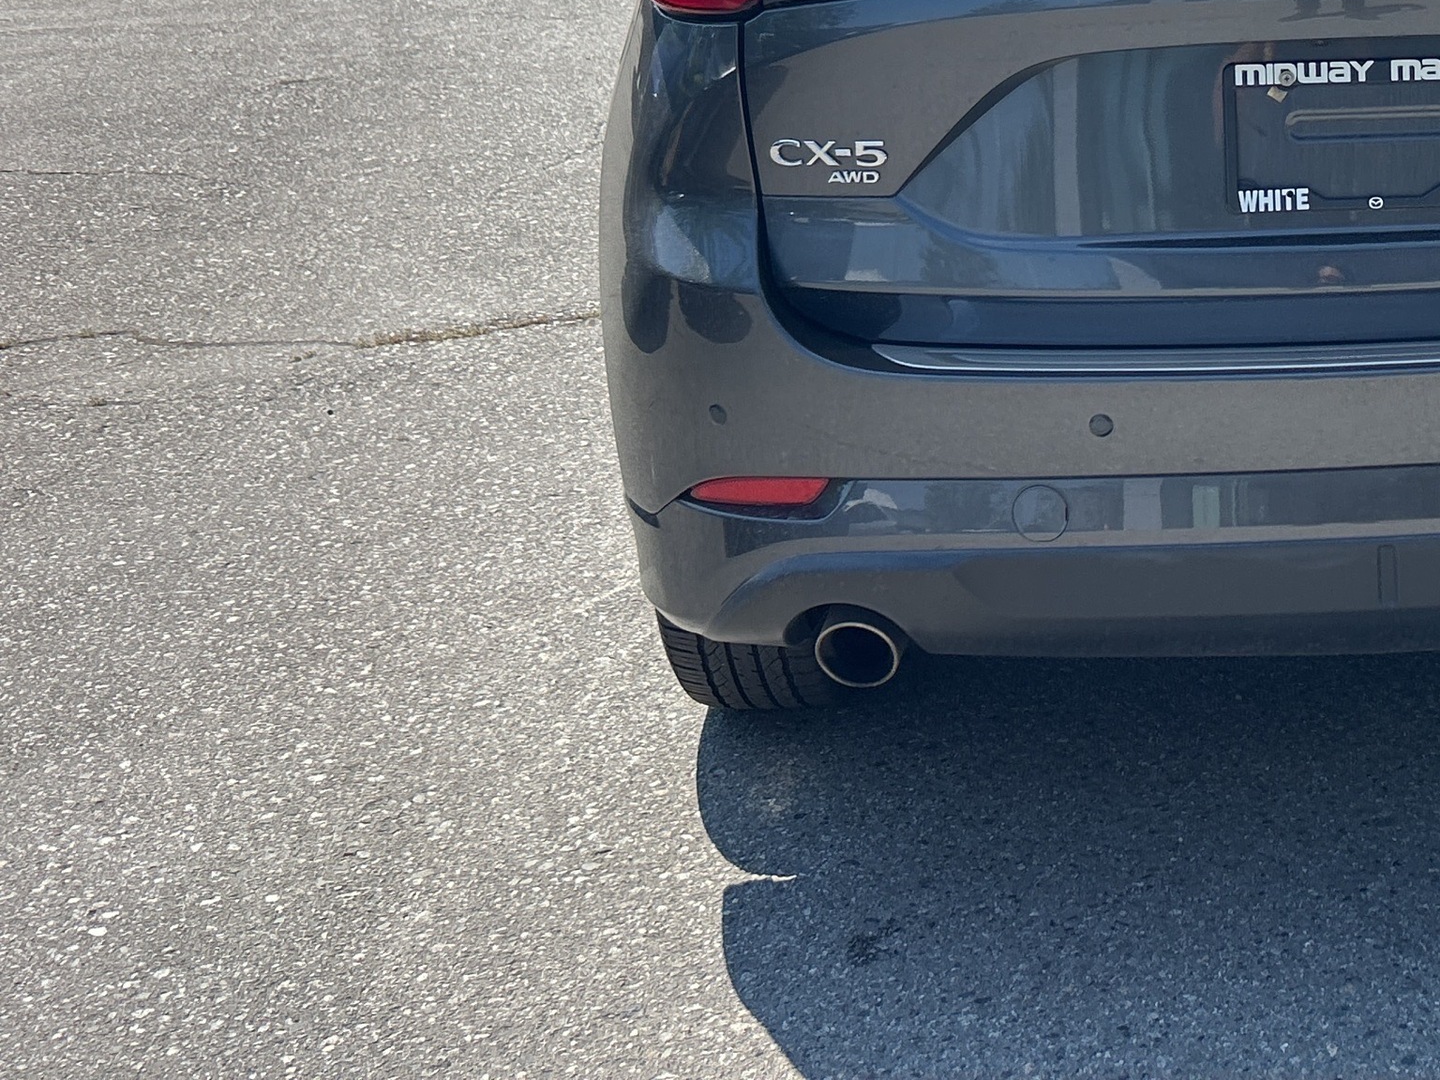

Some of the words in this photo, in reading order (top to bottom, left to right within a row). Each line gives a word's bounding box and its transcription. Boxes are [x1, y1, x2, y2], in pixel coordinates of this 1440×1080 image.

[769, 139, 888, 167] CX-5
[828, 170, 880, 184] AWD
[1237, 187, 1310, 213] WHITE
